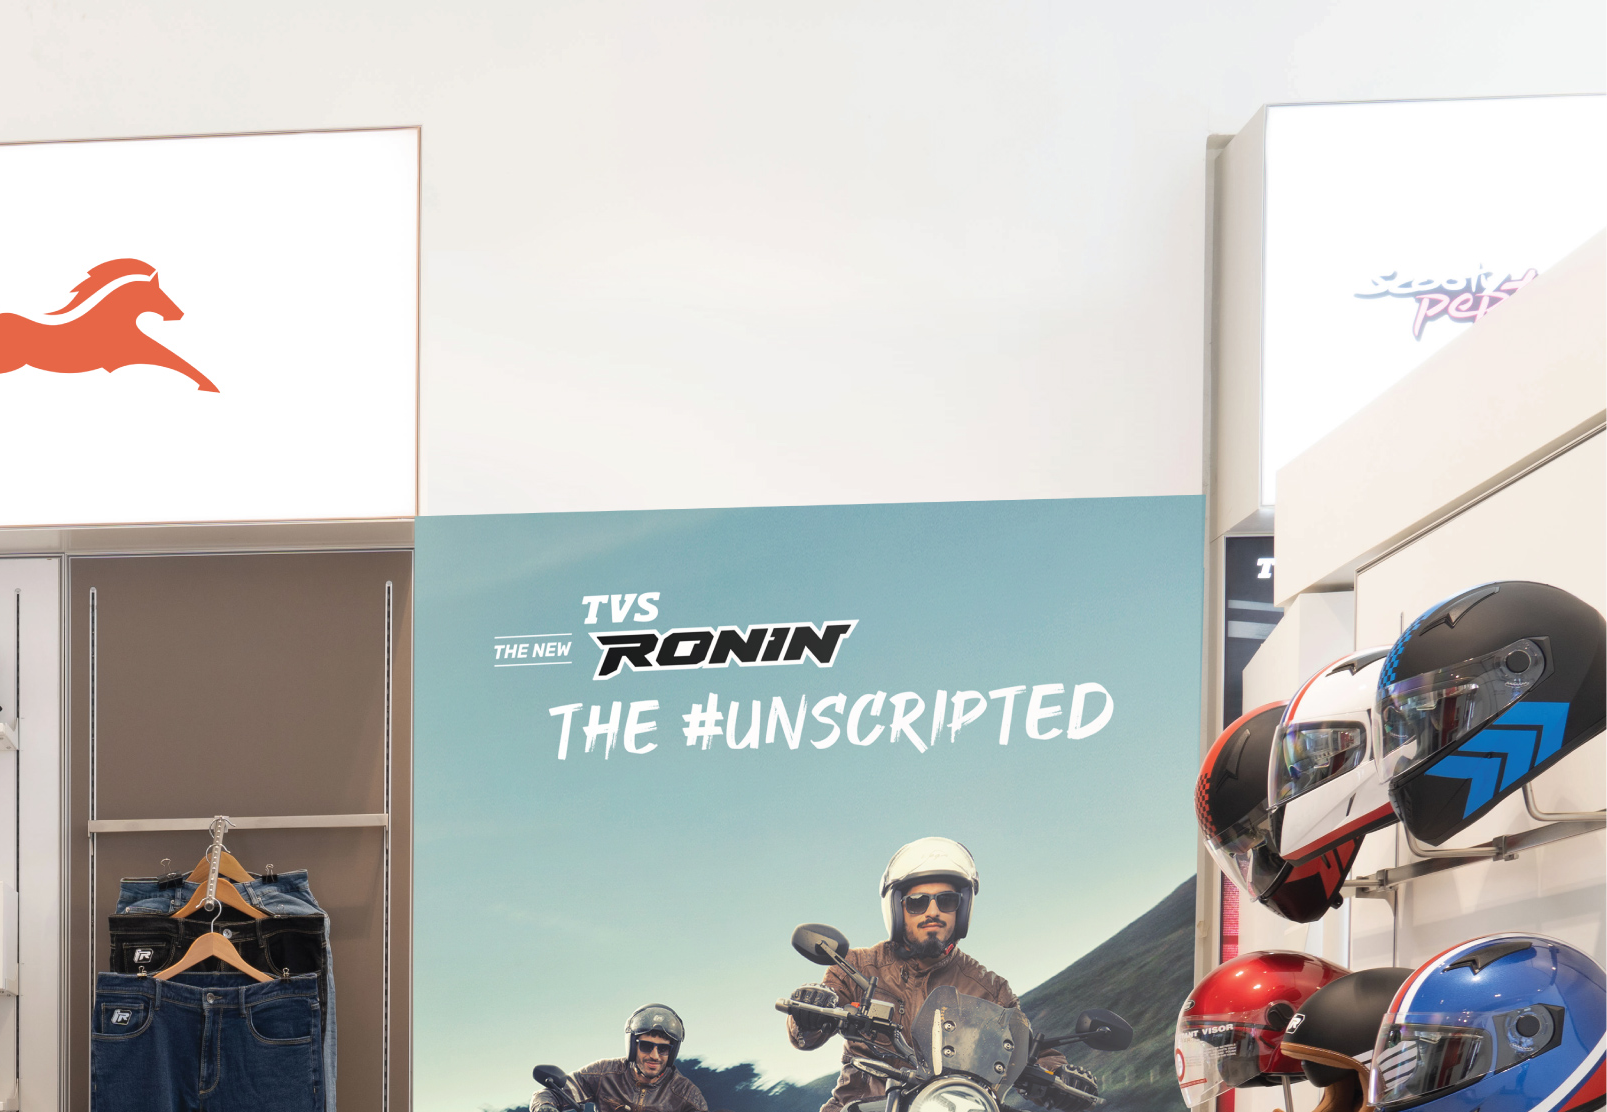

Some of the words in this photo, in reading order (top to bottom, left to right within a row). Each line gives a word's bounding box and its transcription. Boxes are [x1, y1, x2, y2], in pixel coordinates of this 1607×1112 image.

[581, 591, 661, 625] TVS
[494, 643, 530, 660] THE
[531, 641, 572, 658] NEW
[595, 622, 853, 677] RONIN
[548, 699, 661, 761] THE
[681, 681, 1115, 755] #UNSCRIPTED
[1202, 1023, 1234, 1036] VISOR
